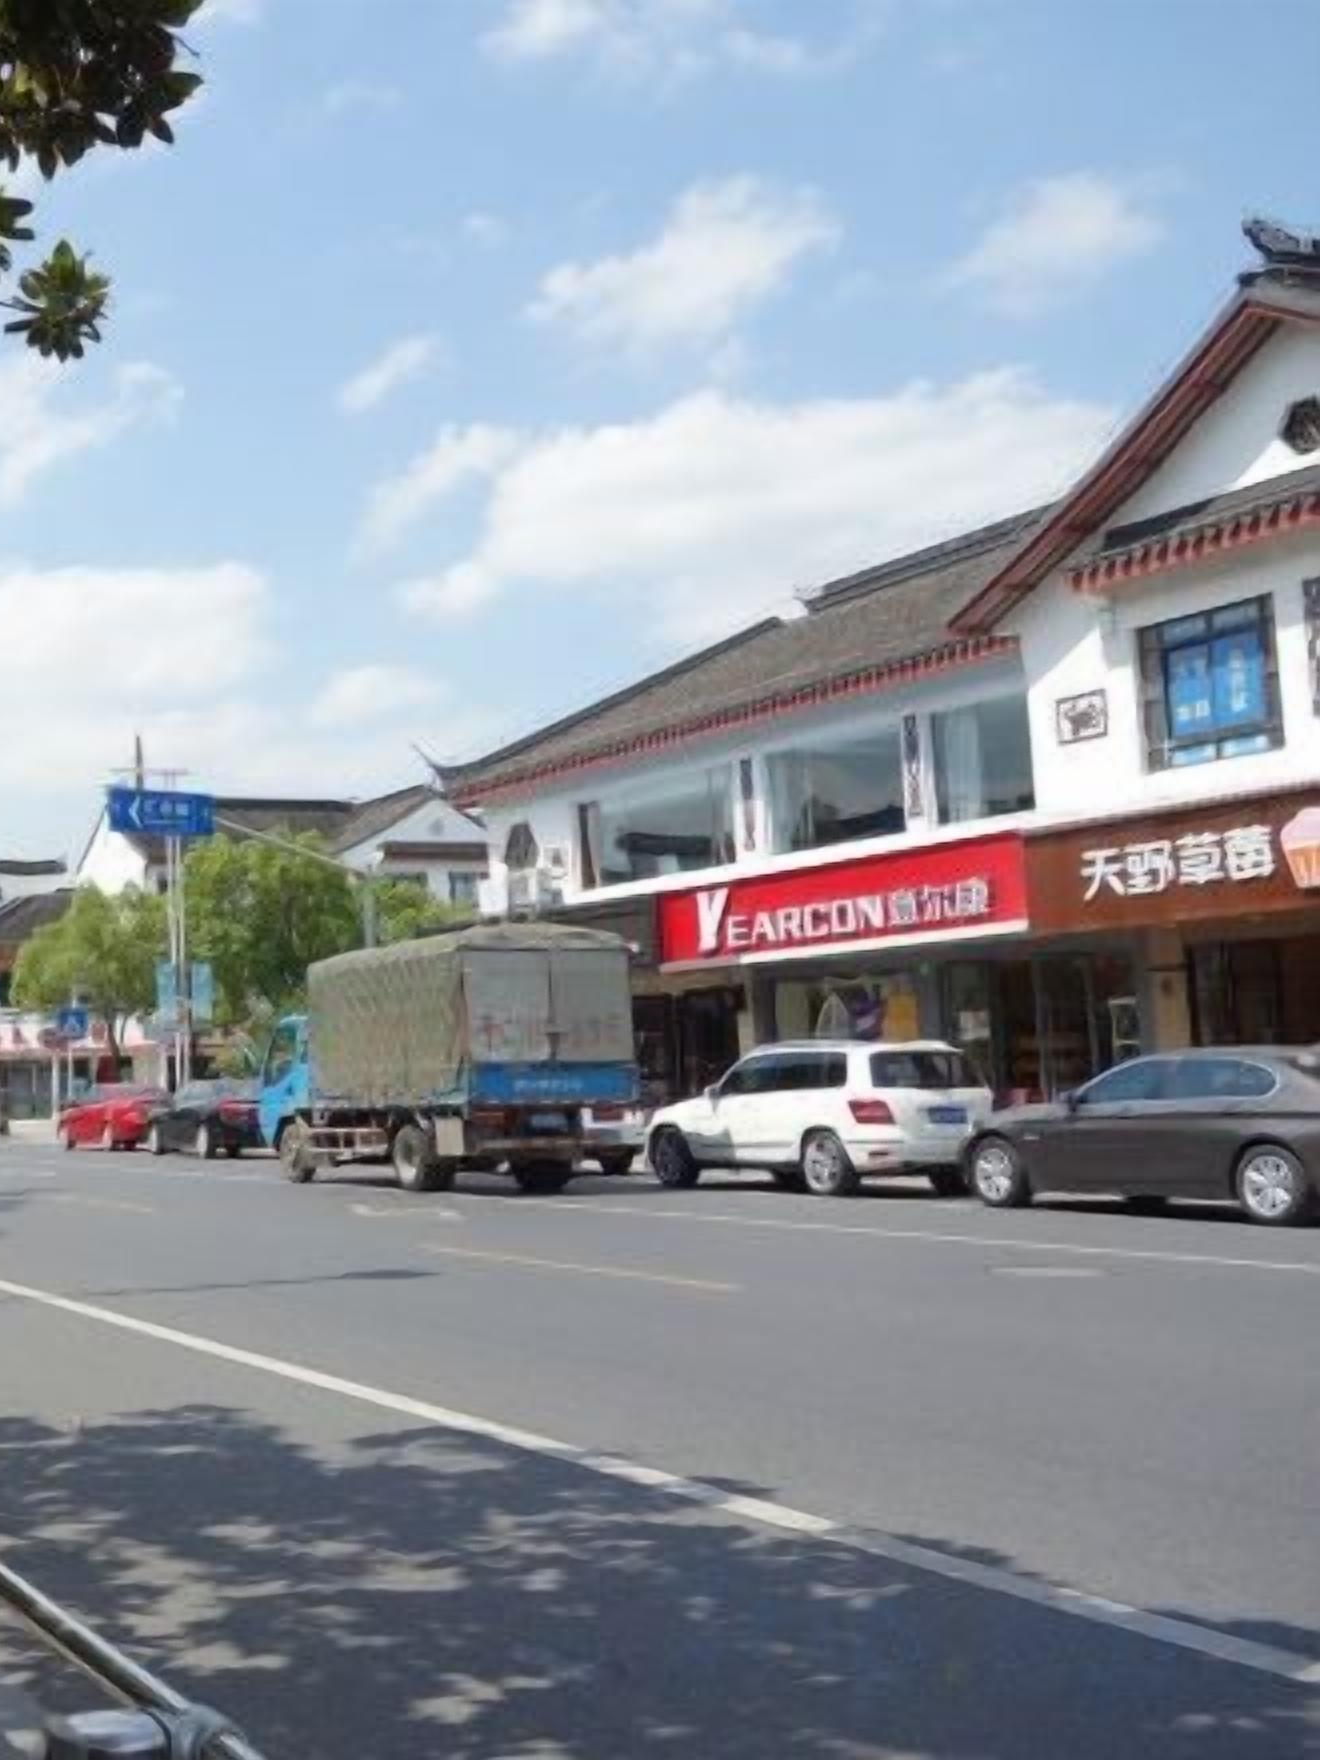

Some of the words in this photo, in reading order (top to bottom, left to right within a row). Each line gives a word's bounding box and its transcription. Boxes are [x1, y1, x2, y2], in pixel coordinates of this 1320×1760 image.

[1081, 825, 1276, 901] 天野草莓
[696, 887, 884, 954] YEARCON
